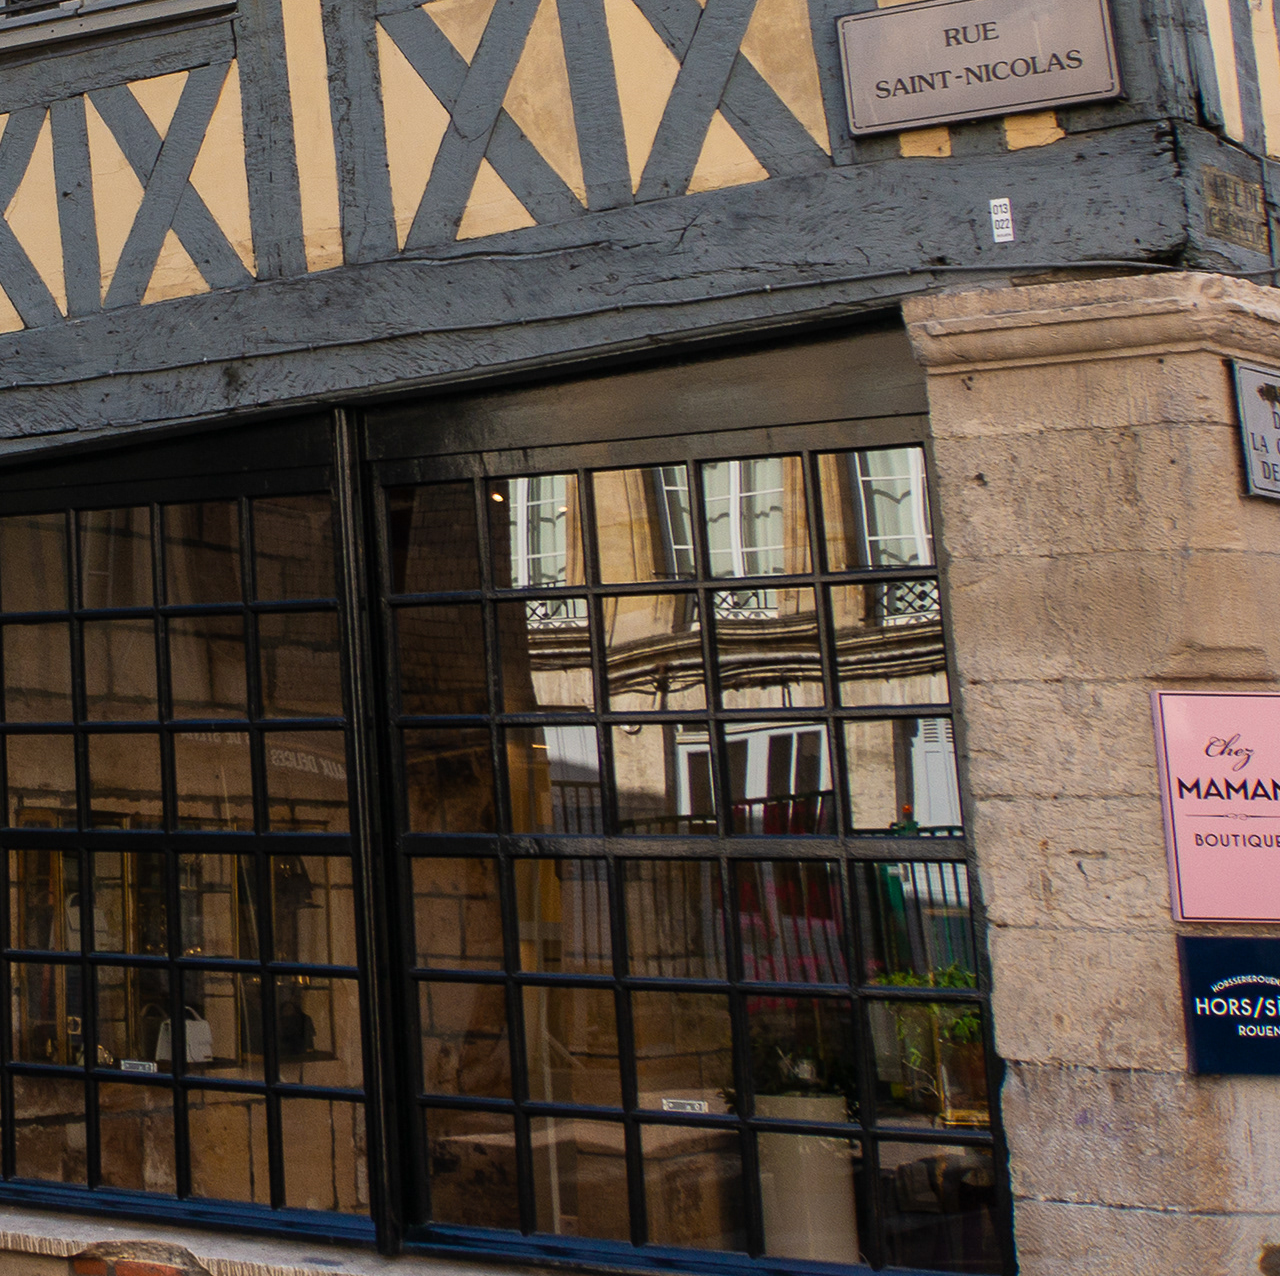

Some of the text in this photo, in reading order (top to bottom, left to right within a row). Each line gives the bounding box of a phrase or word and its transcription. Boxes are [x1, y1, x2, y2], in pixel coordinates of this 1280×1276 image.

[943, 22, 1000, 48] RUE
[875, 49, 1084, 100] SAINT-NICOLAS
[993, 204, 1008, 215] 013
[995, 218, 1010, 230] 022
[1250, 432, 1269, 454] LA
[1261, 461, 1280, 481] DE
[1204, 733, 1255, 771] Chez
[1194, 833, 1280, 848] BOUTIQUE
[1195, 996, 1280, 1018] HORS/S
[1238, 1025, 1280, 1037] ROUEN
